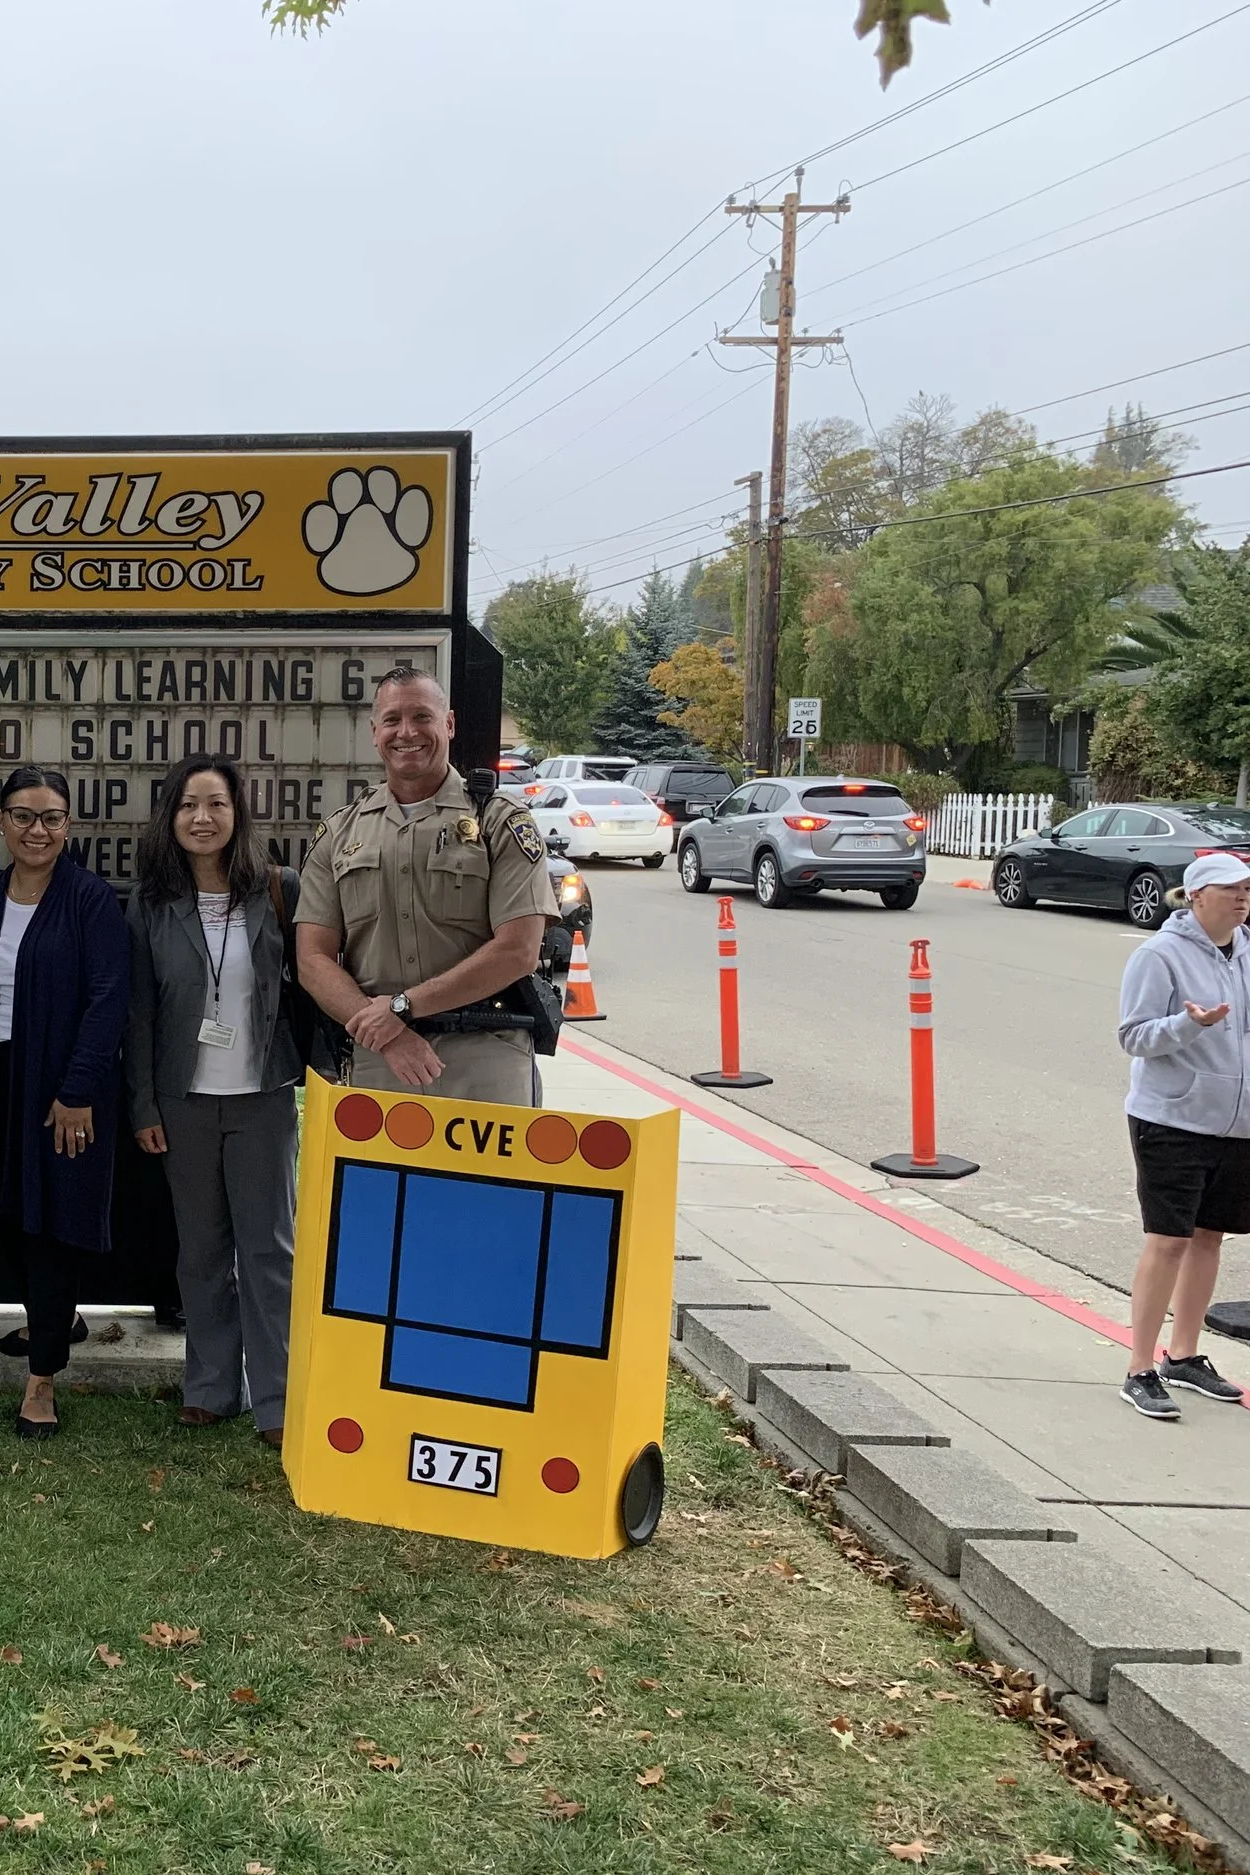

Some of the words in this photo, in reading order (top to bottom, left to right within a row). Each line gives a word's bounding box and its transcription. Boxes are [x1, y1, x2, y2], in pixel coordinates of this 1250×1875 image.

[30, 551, 264, 591] SCHOOL
[115, 660, 313, 701] LEARNING
[71, 719, 275, 761] SCHOOL
[77, 779, 128, 820] UP
[444, 1117, 515, 1157] CVE
[416, 1444, 493, 1489] 375
